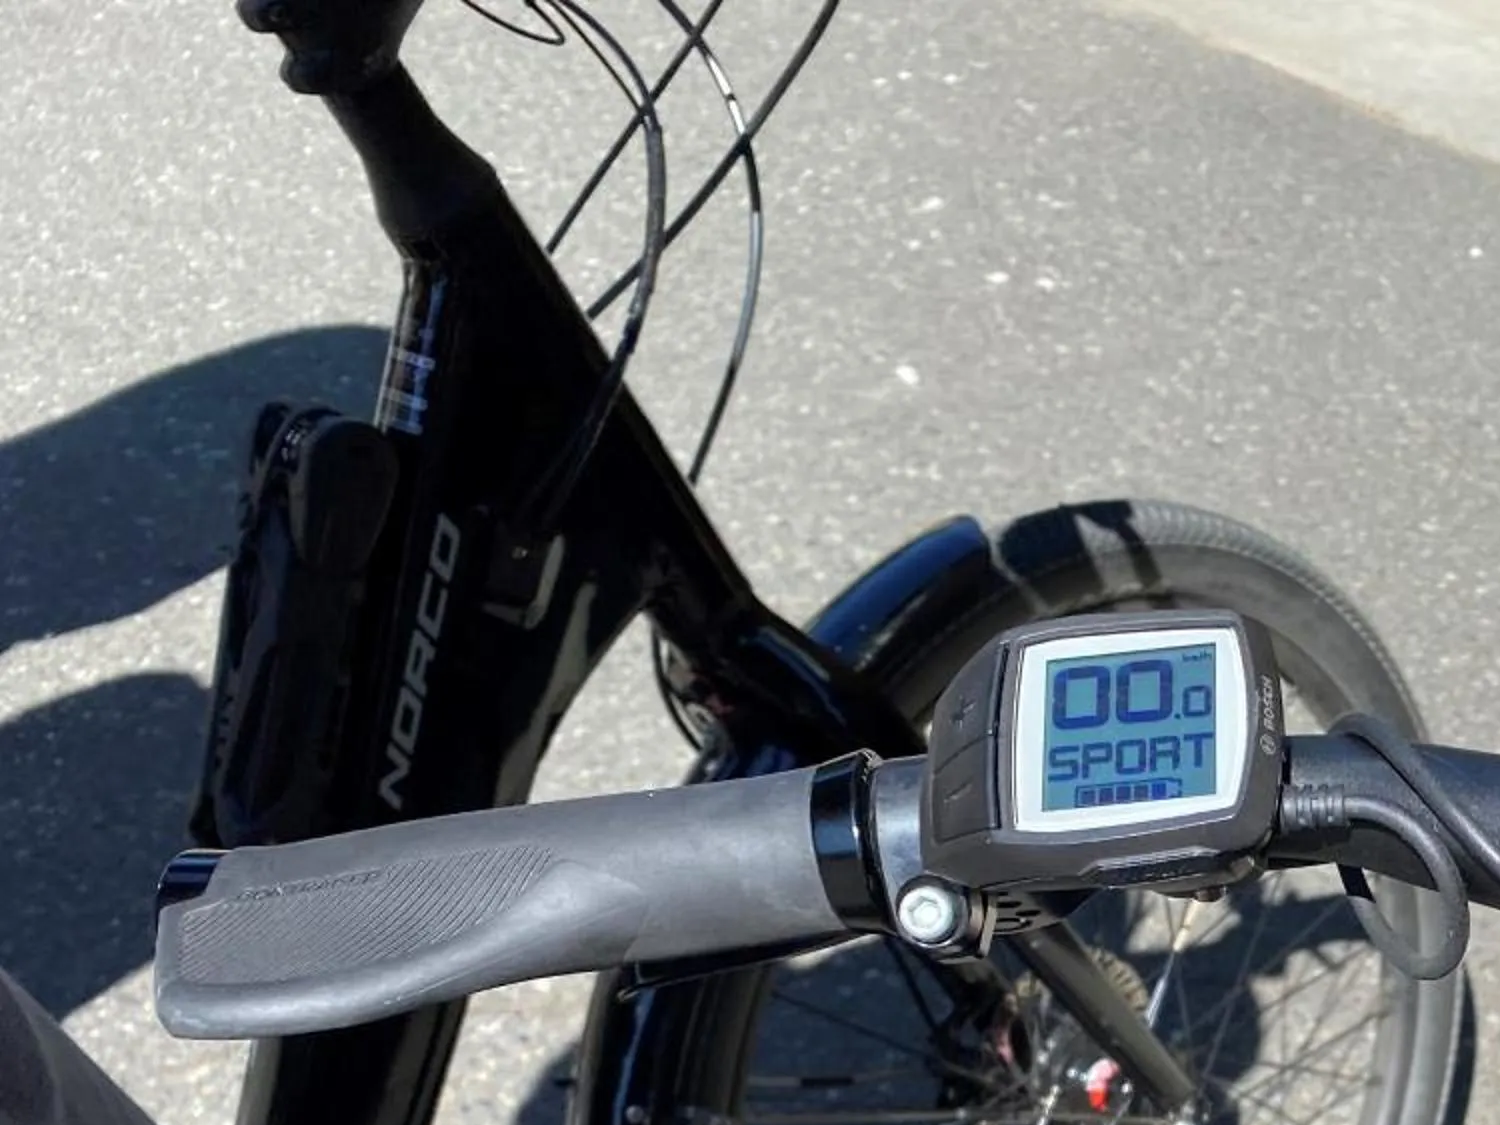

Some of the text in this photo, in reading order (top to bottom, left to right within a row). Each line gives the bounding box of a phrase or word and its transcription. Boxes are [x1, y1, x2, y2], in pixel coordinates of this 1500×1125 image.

[378, 512, 460, 811] NORCO
[1261, 674, 1275, 732] BOSCH
[1048, 732, 1213, 782] SPORT
